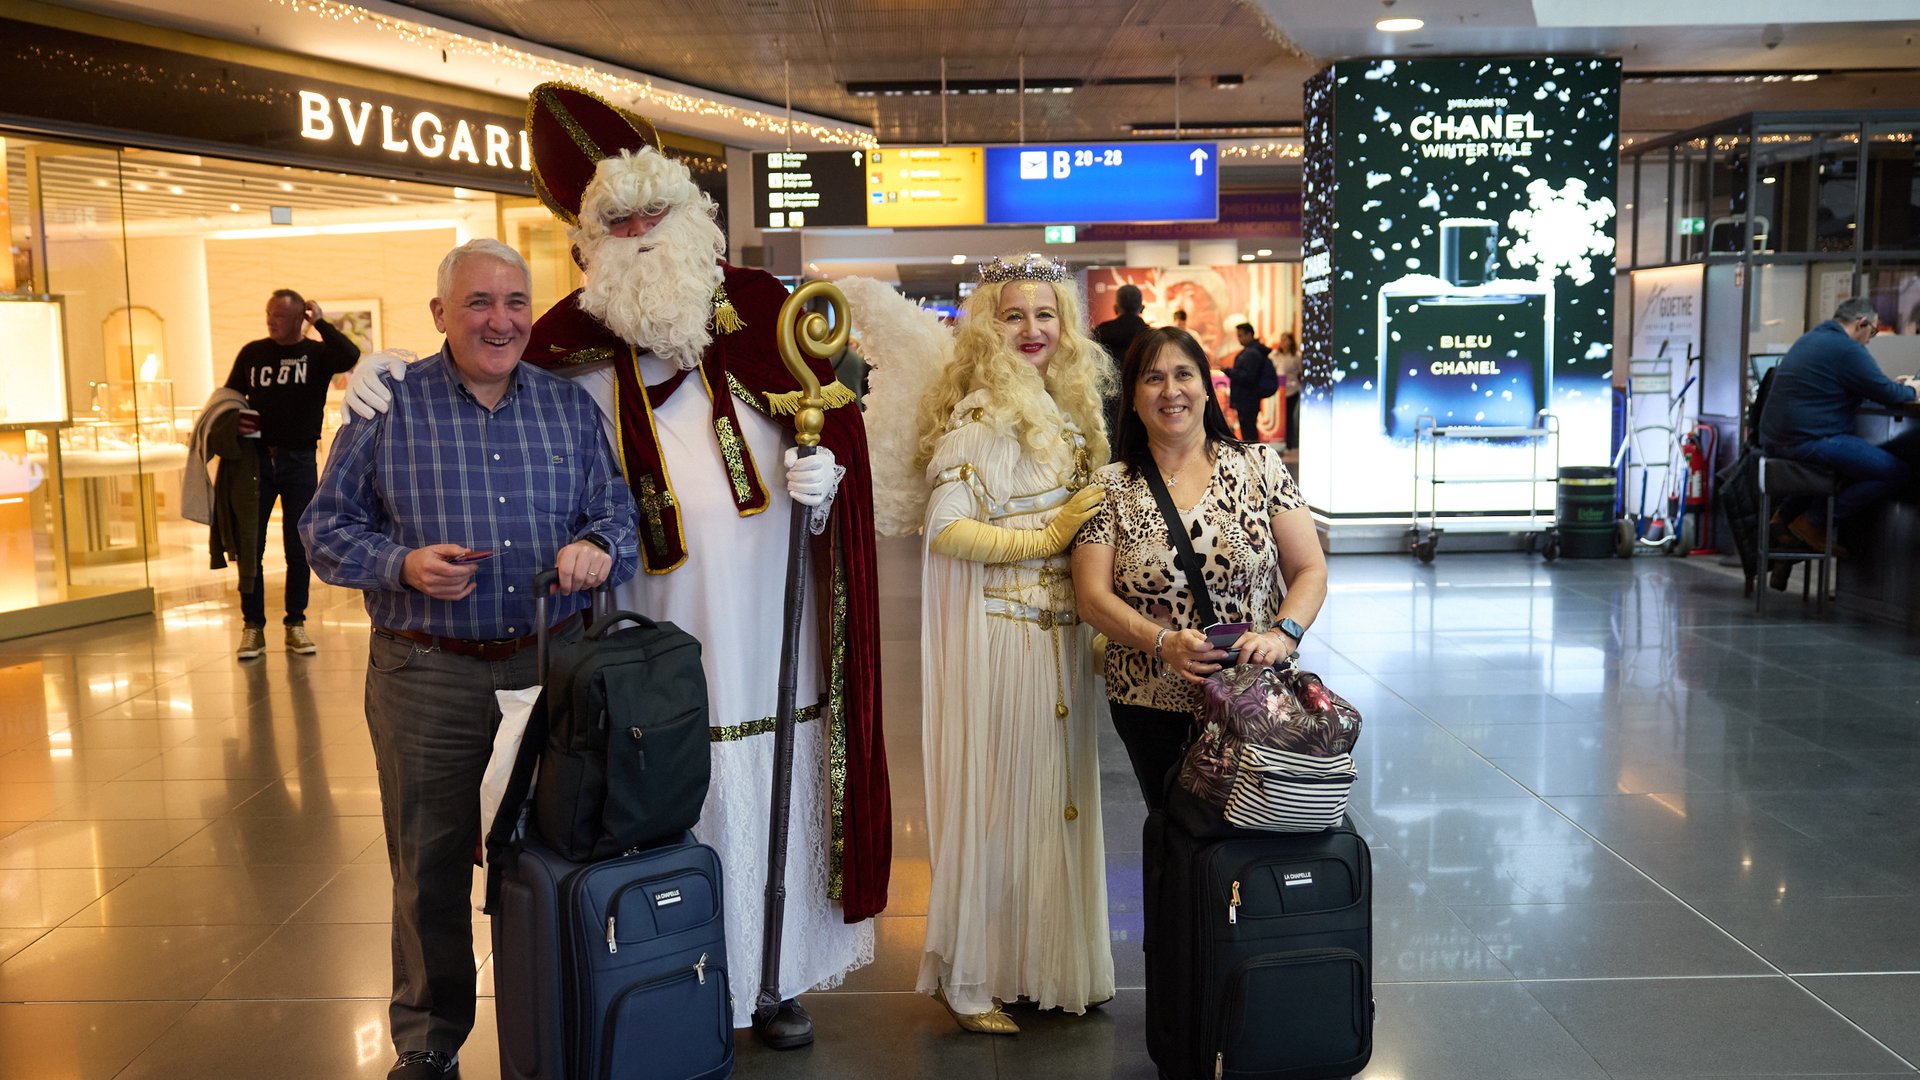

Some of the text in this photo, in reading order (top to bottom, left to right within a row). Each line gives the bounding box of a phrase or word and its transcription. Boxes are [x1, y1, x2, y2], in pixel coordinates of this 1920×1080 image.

[299, 90, 532, 172] BVLGARI
[1410, 113, 1544, 141] CHANEL
[1421, 141, 1532, 158] WINTER TALE
[1052, 150, 1071, 180] B
[1440, 334, 1492, 349] BLEU
[250, 362, 308, 388] ICON
[1430, 360, 1501, 376] CHANEL
[1290, 871, 1312, 880] CHAPELLE
[655, 893, 661, 901] LA
